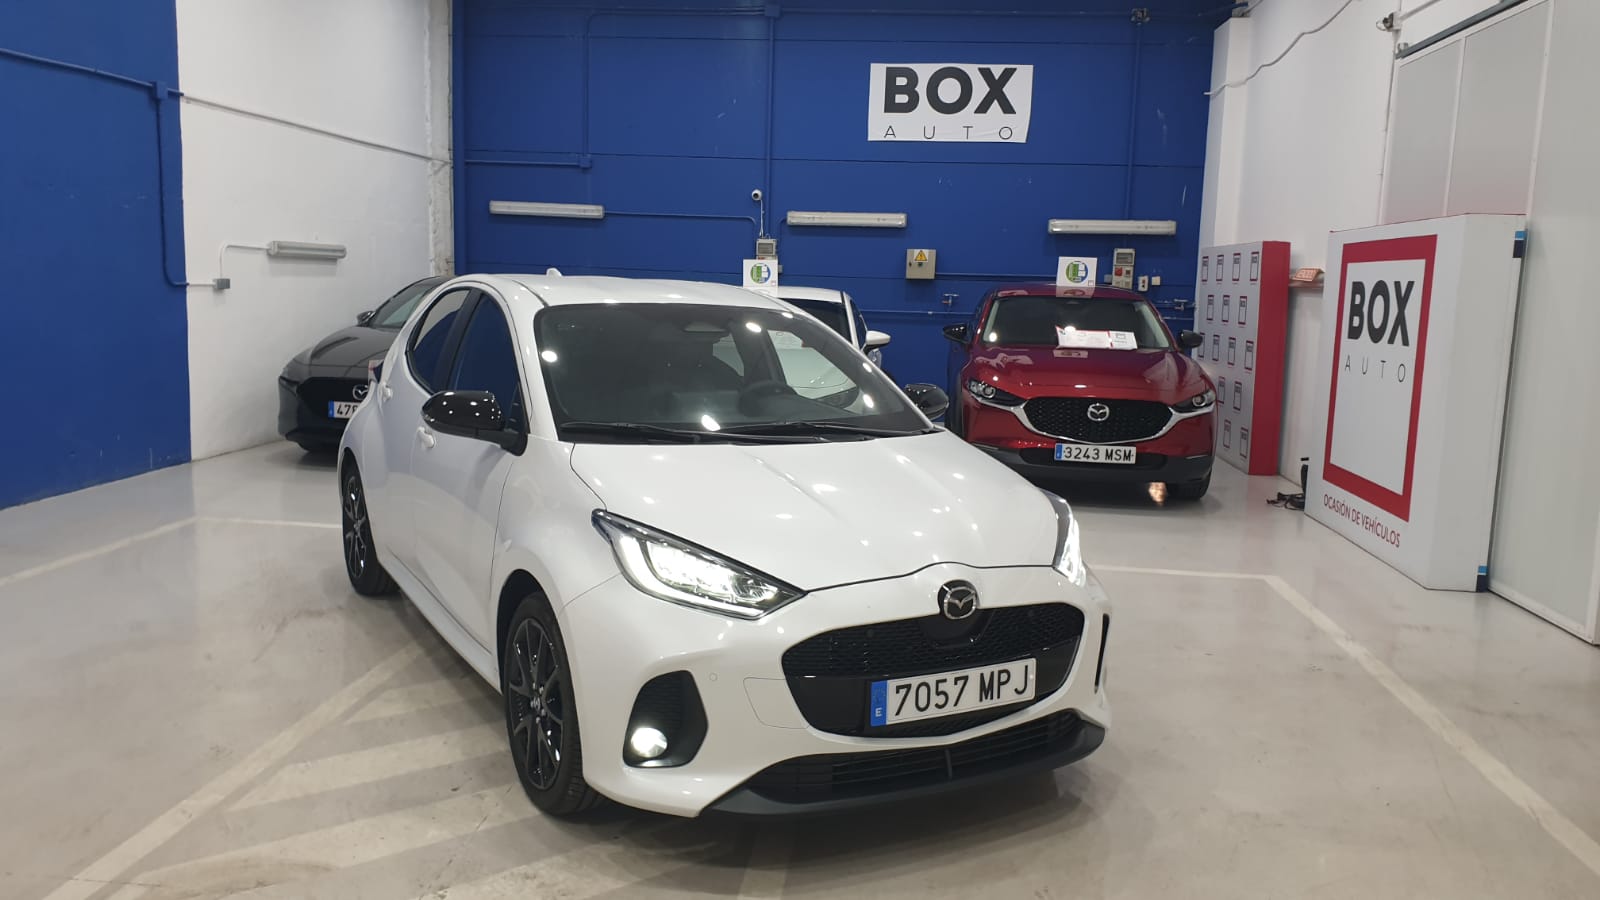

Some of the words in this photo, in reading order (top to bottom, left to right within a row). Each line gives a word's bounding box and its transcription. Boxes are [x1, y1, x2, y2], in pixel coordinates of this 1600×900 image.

[884, 66, 1018, 115] BOX
[884, 125, 1013, 140] AUTO
[1347, 280, 1415, 347] BOX
[1344, 354, 1406, 383] AUTO
[1064, 446, 1100, 461] 3243
[1104, 448, 1132, 462] MSM
[1323, 493, 1351, 520] OCASIÓN
[1351, 508, 1361, 526] DE
[1361, 513, 1401, 548] VEHÍCULOS
[895, 675, 969, 716] 7057
[979, 664, 1029, 702] MPJ
[875, 707, 882, 717] E
